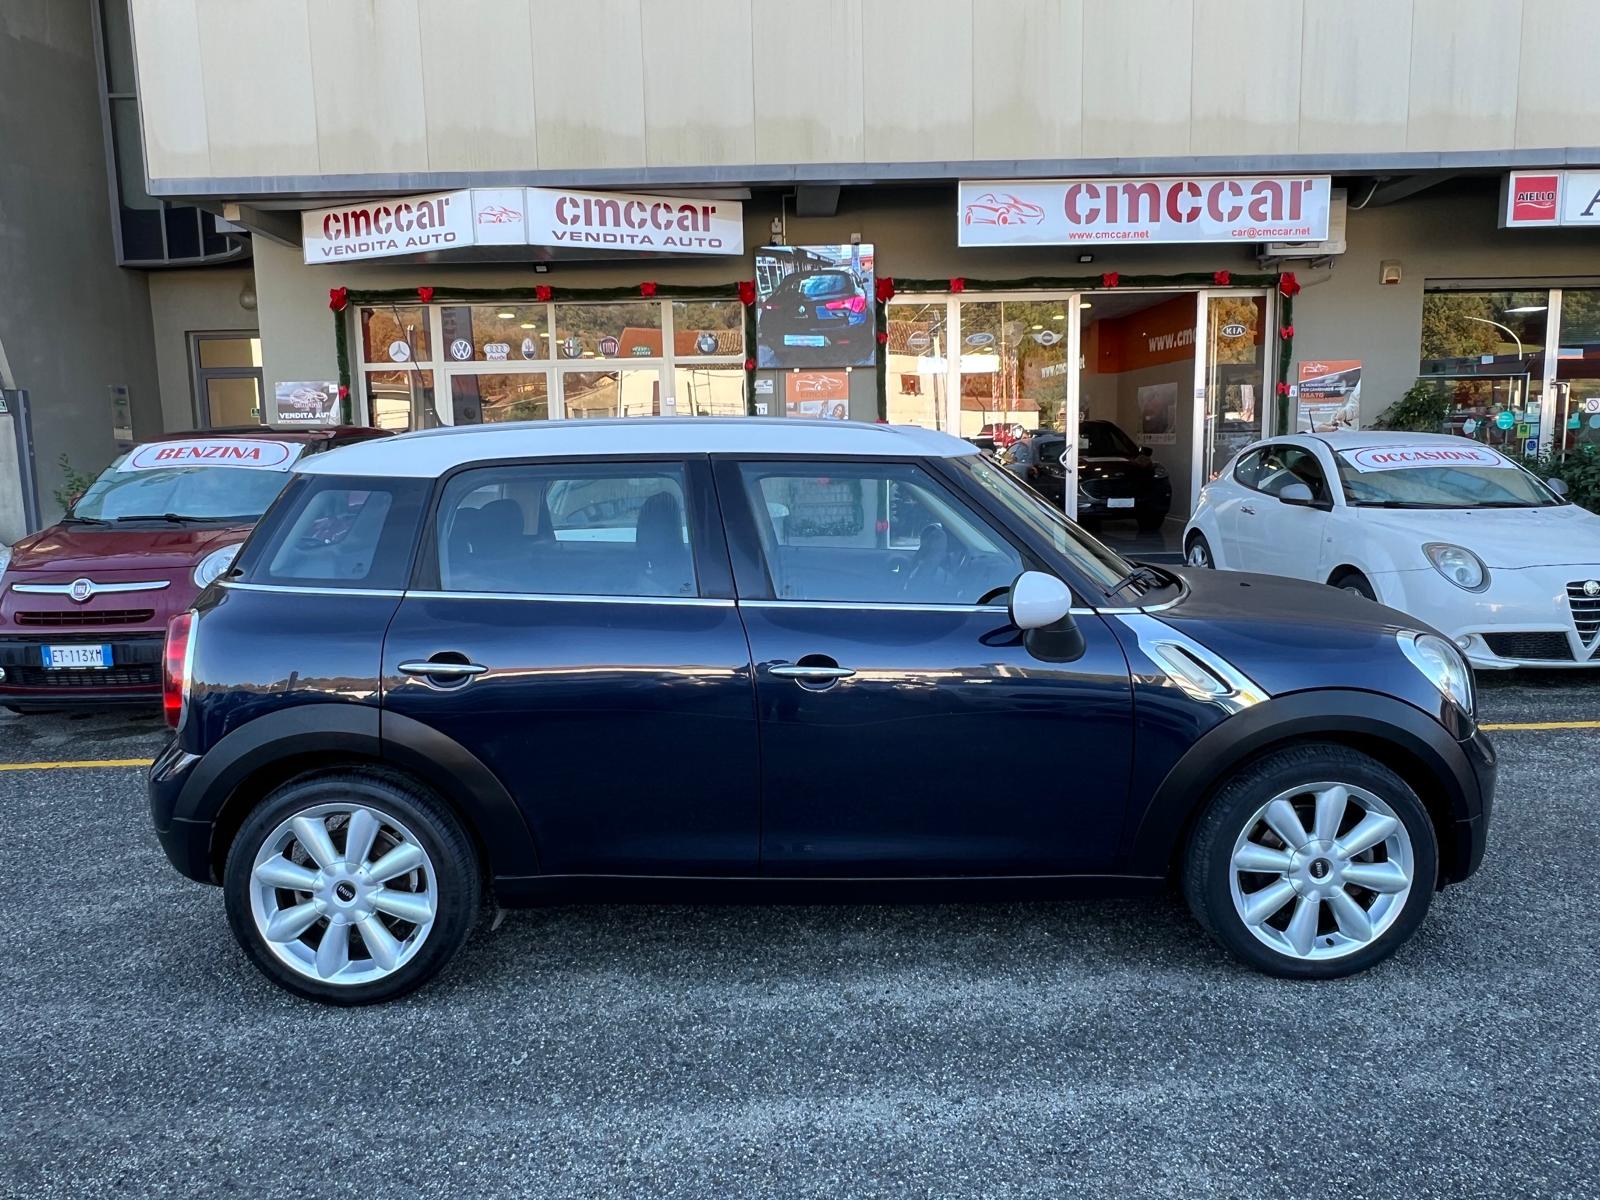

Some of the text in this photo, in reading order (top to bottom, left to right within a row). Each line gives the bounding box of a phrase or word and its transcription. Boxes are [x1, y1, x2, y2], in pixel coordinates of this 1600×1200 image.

[1064, 179, 1312, 225] cmccar
[1517, 192, 1555, 201] AIELLO
[323, 198, 449, 240] cmccar
[555, 197, 716, 232] cmccar
[552, 230, 722, 248] VENDITA AUTO
[1068, 229, 1149, 239] www.cmccar.net
[1231, 226, 1311, 238] car@cmccar.net
[322, 232, 456, 256] VENDITA AUTO
[602, 342, 615, 353] FIAT
[155, 446, 260, 460] BENZINA
[1372, 451, 1486, 463] OCCASIONE
